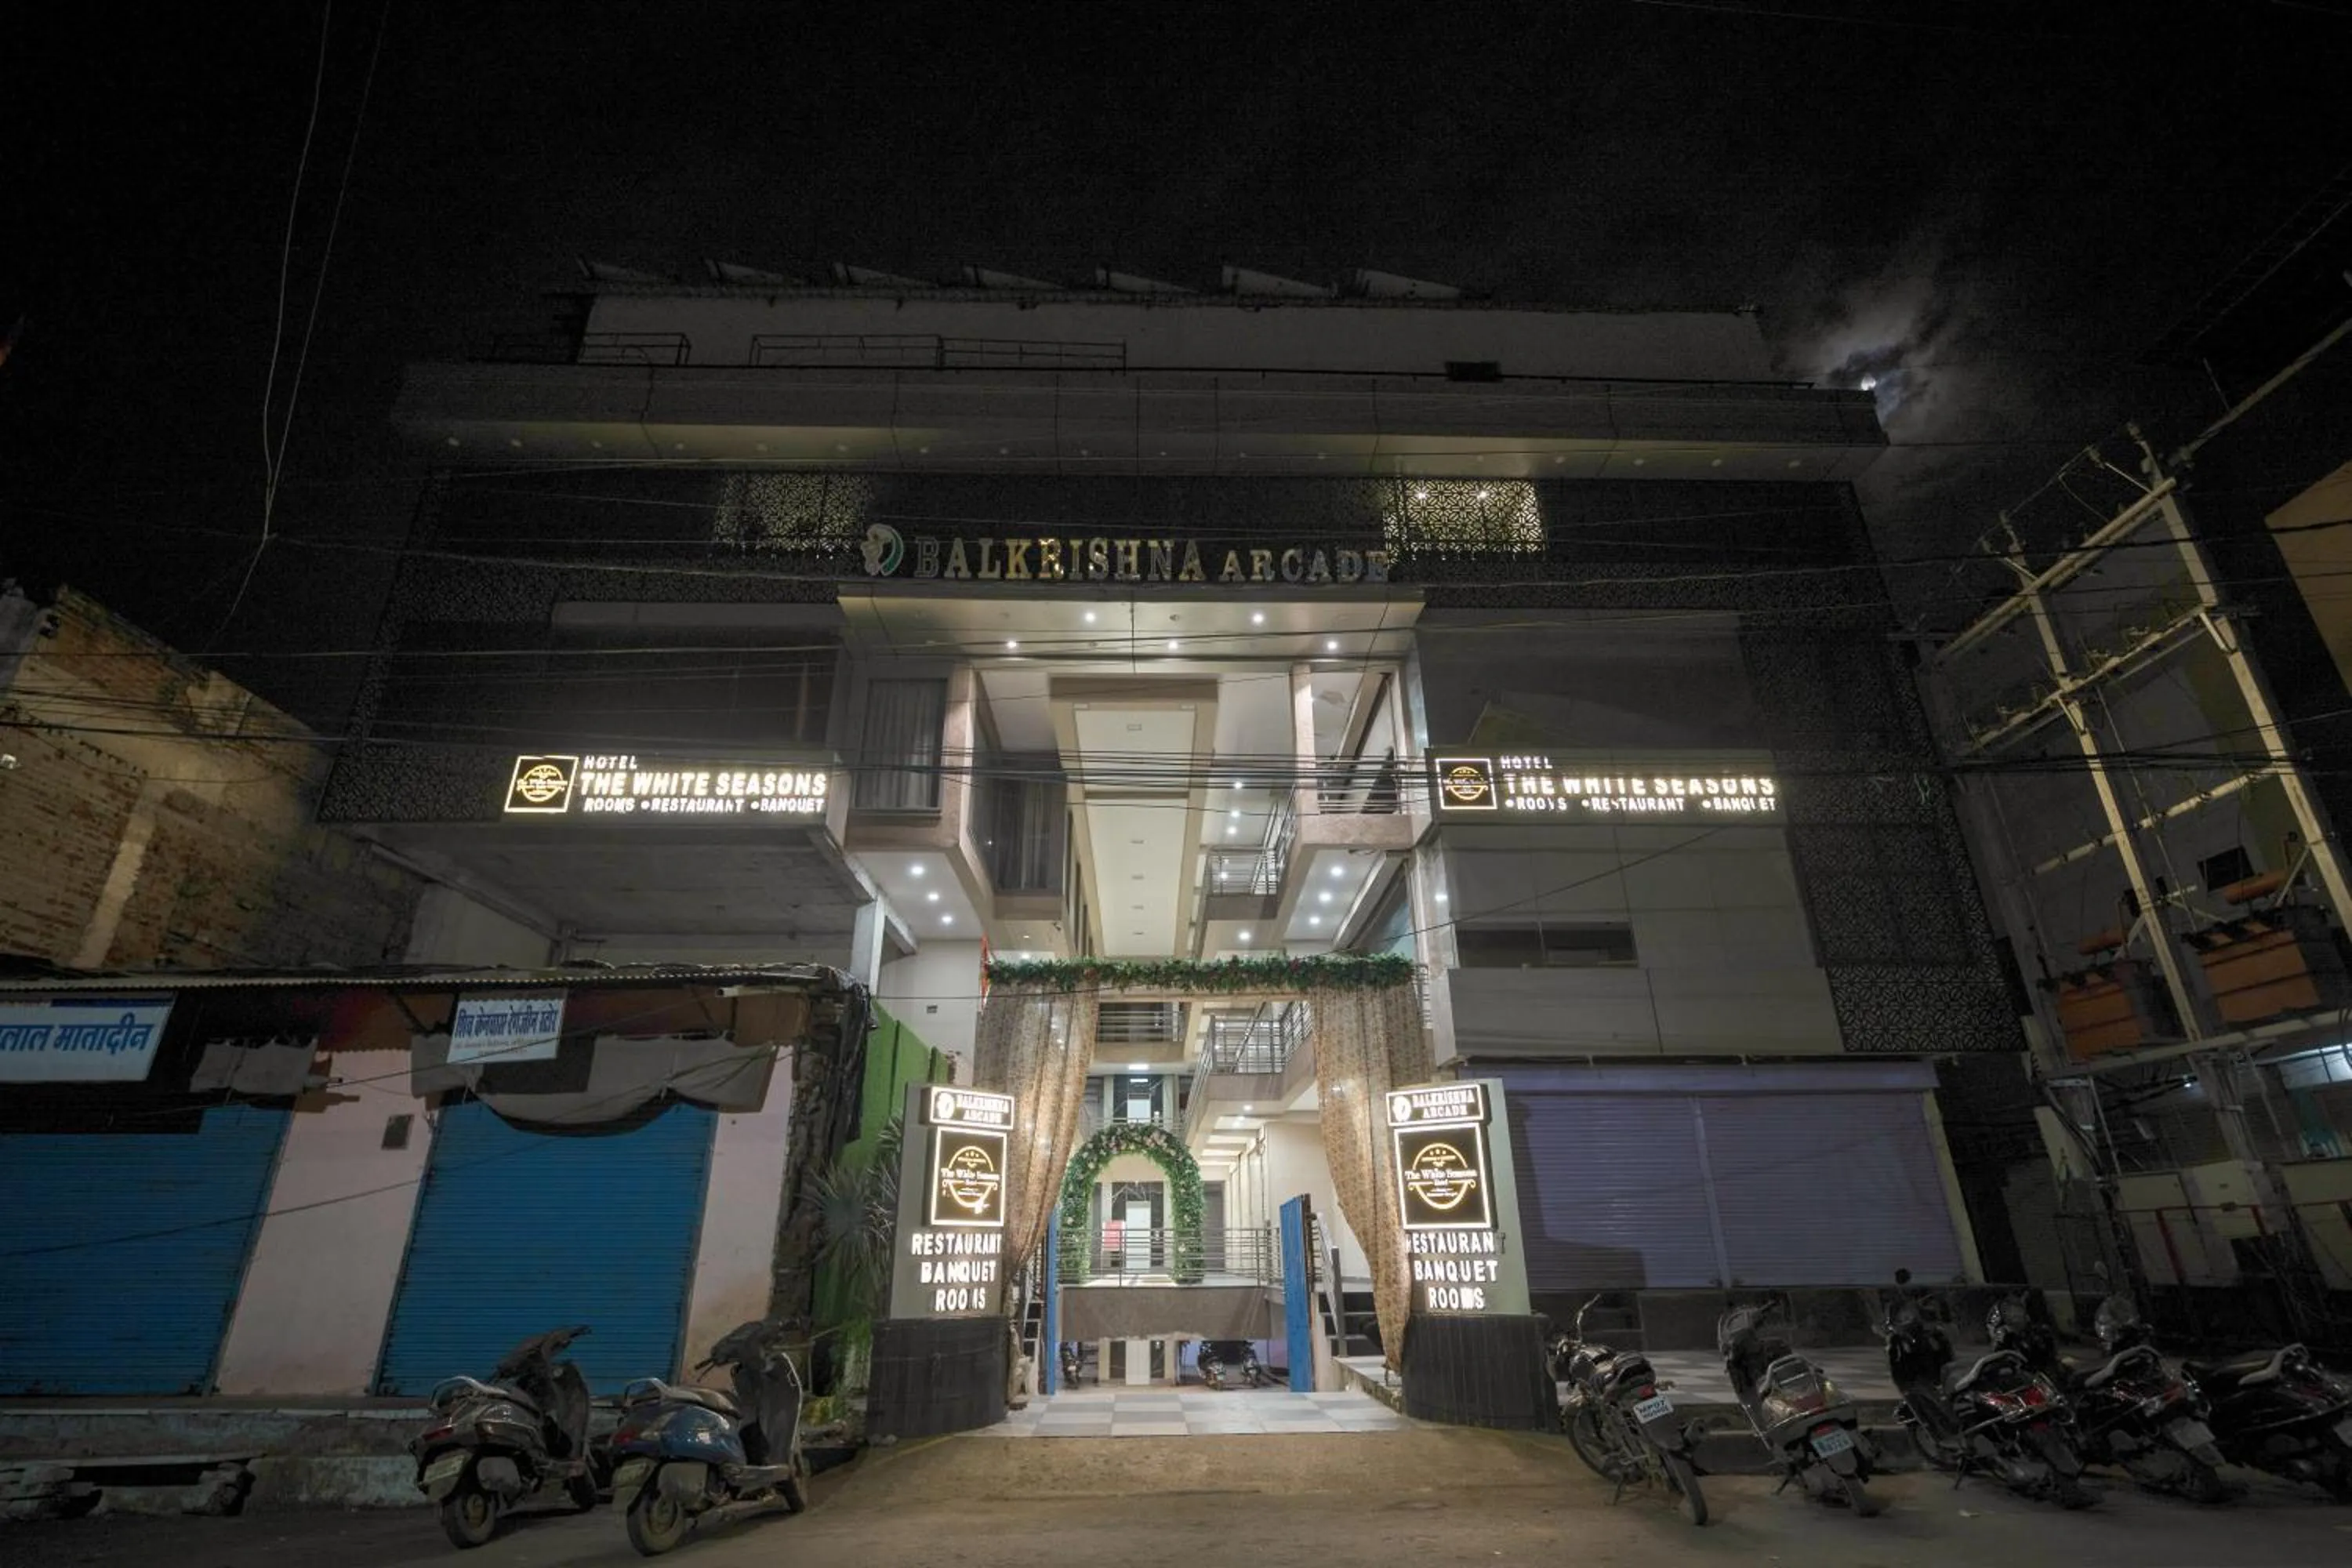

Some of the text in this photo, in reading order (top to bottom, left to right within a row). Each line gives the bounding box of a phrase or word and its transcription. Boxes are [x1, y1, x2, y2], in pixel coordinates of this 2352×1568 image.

[913, 536, 1389, 583] BALKRISHNA ARCADE
[583, 755, 638, 770] HOTEL
[1499, 755, 1554, 770] HOTEL
[580, 772, 628, 797] THE
[632, 772, 711, 797] WHITE
[715, 772, 828, 797] SEASONS
[1503, 773, 1556, 796] THE
[1563, 775, 1648, 796] WHITE
[1654, 775, 1776, 796] SEASONS
[583, 798, 825, 812] ROOMS RESTAURANT BANQUET
[0, 1011, 155, 1055] लाल मातादीन
[911, 1232, 1002, 1255] RESTAURANT
[920, 1260, 996, 1283] BANQUET
[1414, 1259, 1499, 1282] BANQUET
[1428, 1287, 1485, 1310] ROOMS
